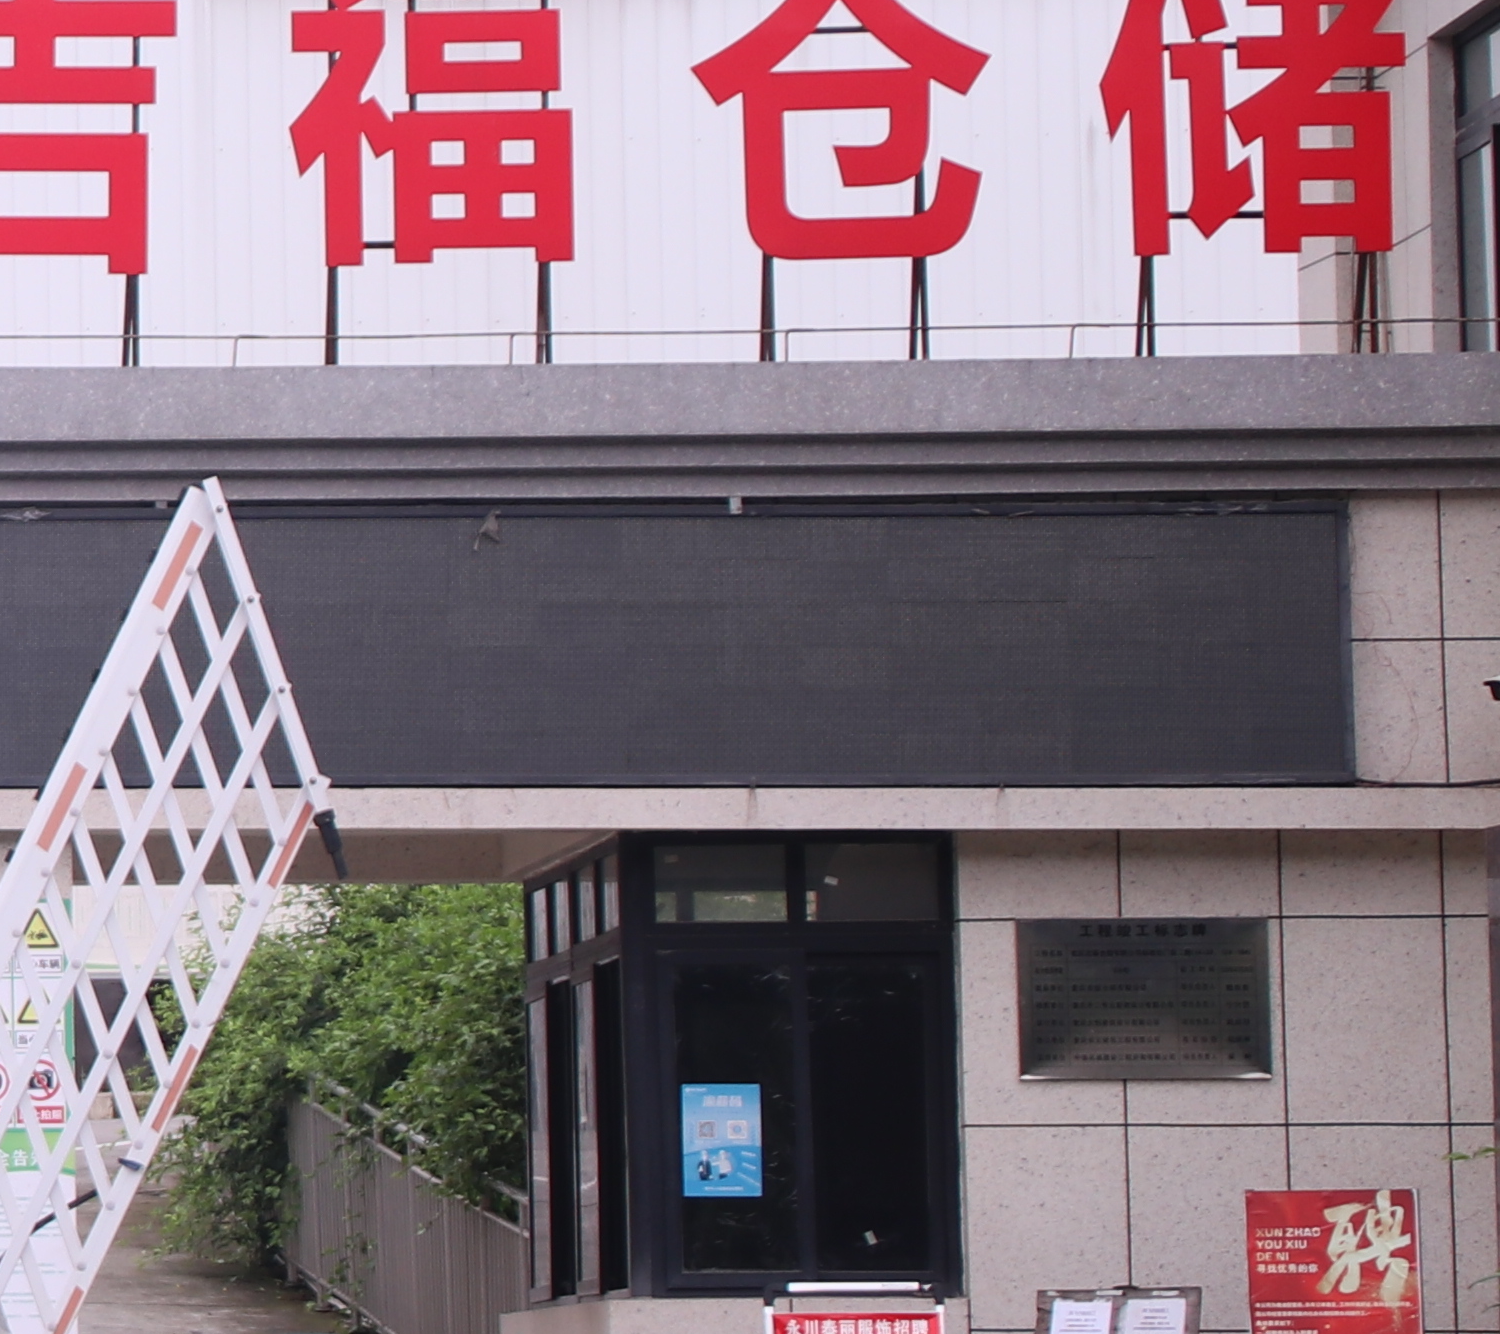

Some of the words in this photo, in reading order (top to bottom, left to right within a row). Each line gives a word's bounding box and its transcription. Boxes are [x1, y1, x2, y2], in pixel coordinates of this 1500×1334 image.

[1256, 1228, 1283, 1238] XUN
[1285, 1227, 1321, 1238] ZHAO
[1256, 1239, 1283, 1250] YOU
[1285, 1239, 1308, 1249] XIU
[1315, 1189, 1411, 1307] 聘
[1256, 1251, 1273, 1262] DE
[1276, 1251, 1290, 1261] NI
